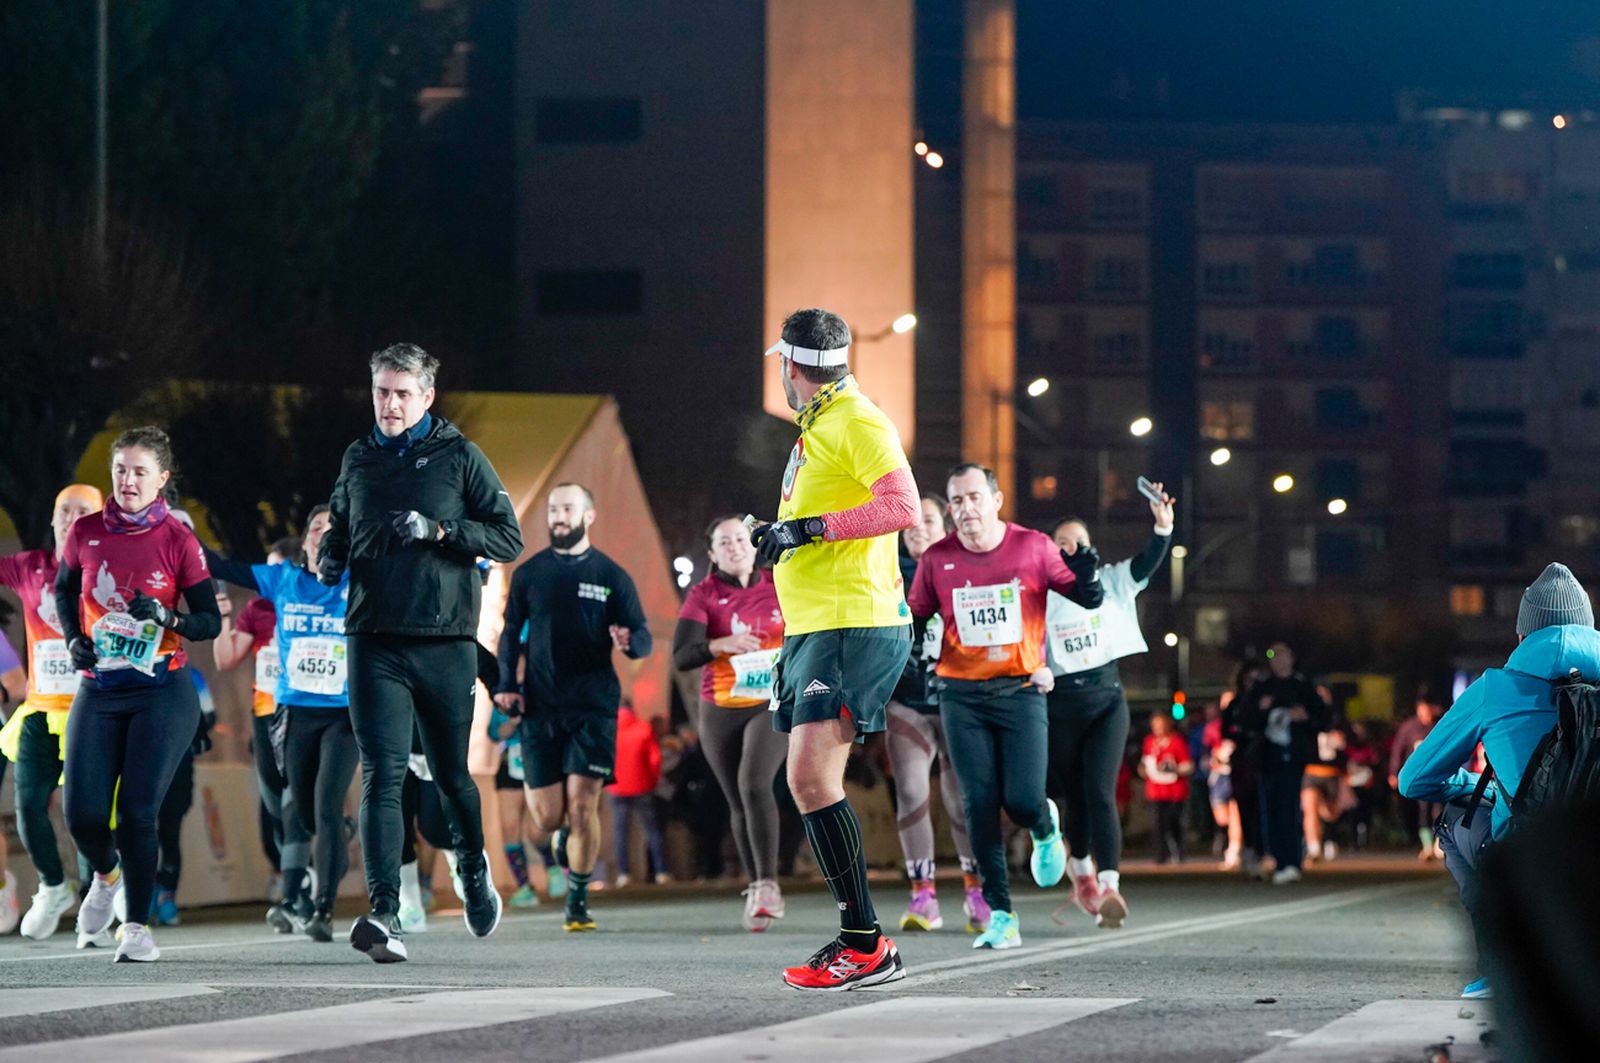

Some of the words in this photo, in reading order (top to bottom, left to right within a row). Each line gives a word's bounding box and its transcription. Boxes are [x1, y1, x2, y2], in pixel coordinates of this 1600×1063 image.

[969, 606, 1007, 626] 1434
[1064, 632, 1098, 653] 6347
[297, 657, 337, 676] 4555
